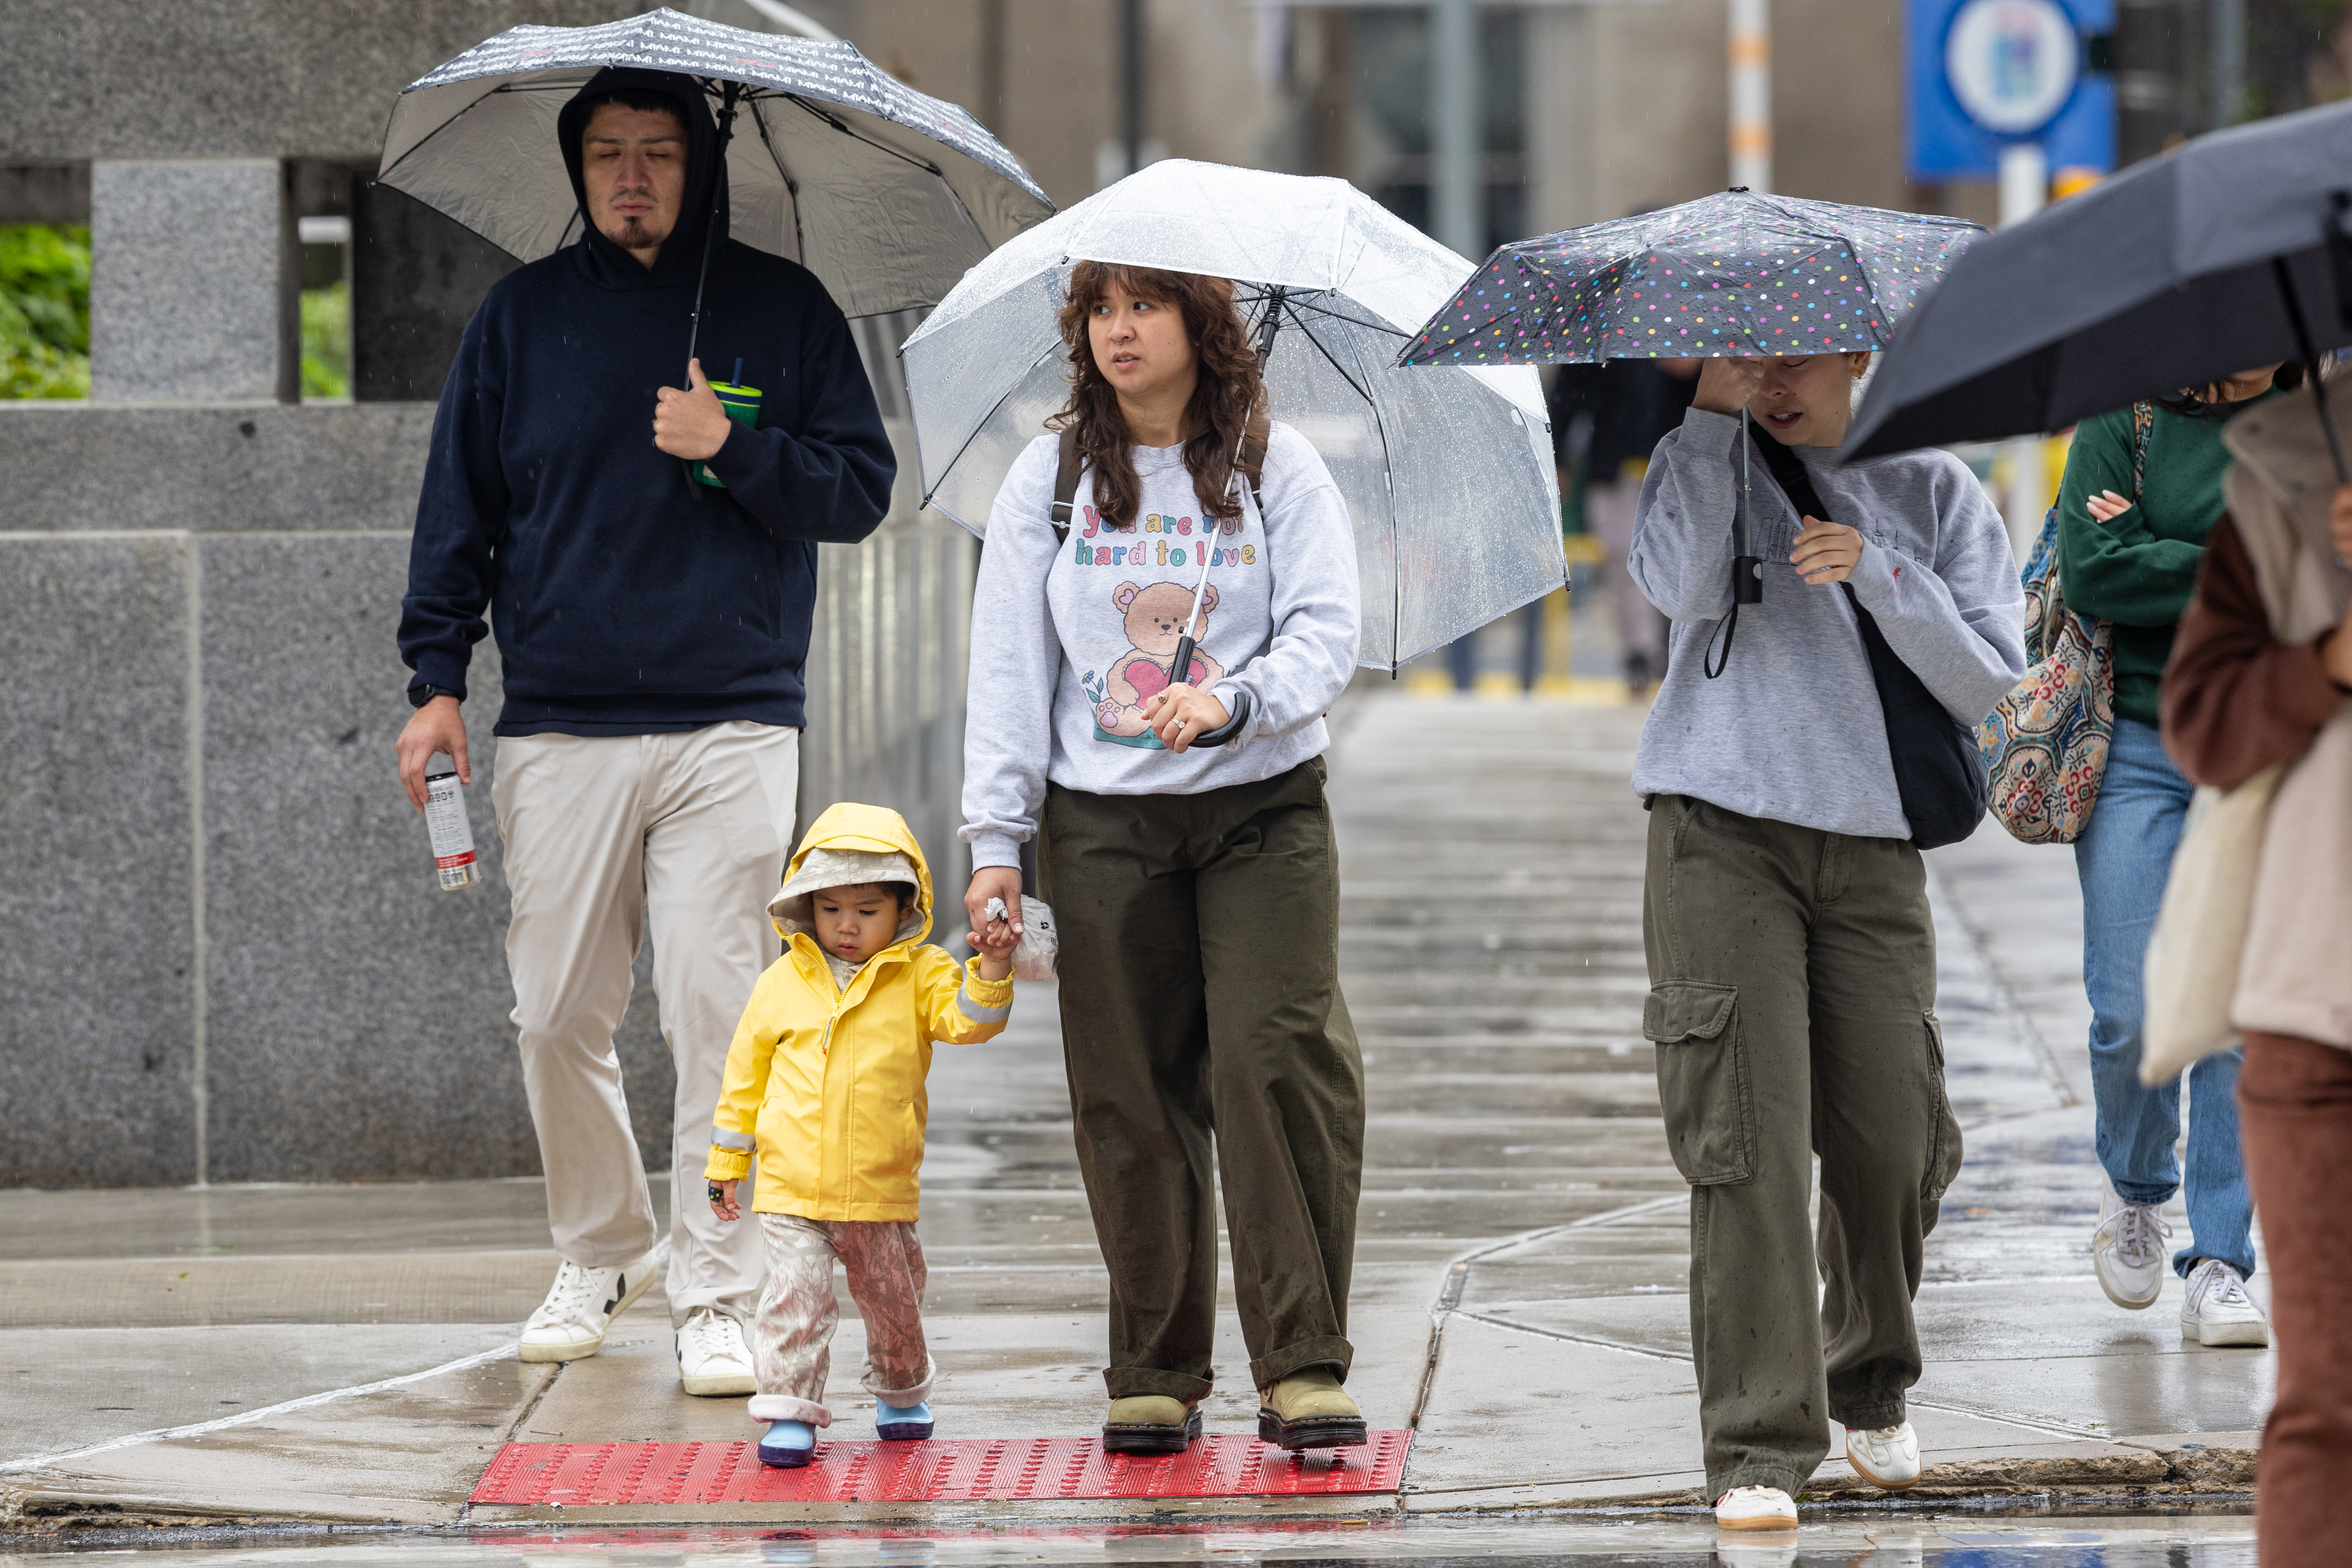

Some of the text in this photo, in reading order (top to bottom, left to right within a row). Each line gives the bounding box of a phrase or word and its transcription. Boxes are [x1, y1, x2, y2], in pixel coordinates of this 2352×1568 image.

[662, 7, 699, 24] MIAMI
[798, 39, 837, 49] MIAMI
[688, 26, 726, 38] MIAMI
[779, 44, 818, 56] MIAMI
[641, 41, 680, 54] MIAMI
[687, 49, 726, 61] MIAMI
[779, 65, 818, 78] MIAMI
[825, 74, 864, 89] MIAMI
[660, 32, 700, 45] MIAMI
[706, 40, 745, 53] MIAMI
[752, 49, 791, 61] MIAMI
[798, 58, 837, 71] MIAMI
[659, 57, 699, 67] MIAMI
[706, 63, 745, 75] MIAMI
[752, 70, 791, 84] MIAMI
[798, 79, 837, 94] MIAMI
[843, 91, 882, 107] MIAMI
[1145, 514, 1192, 535] are
[1075, 538, 1256, 567] hard to love
